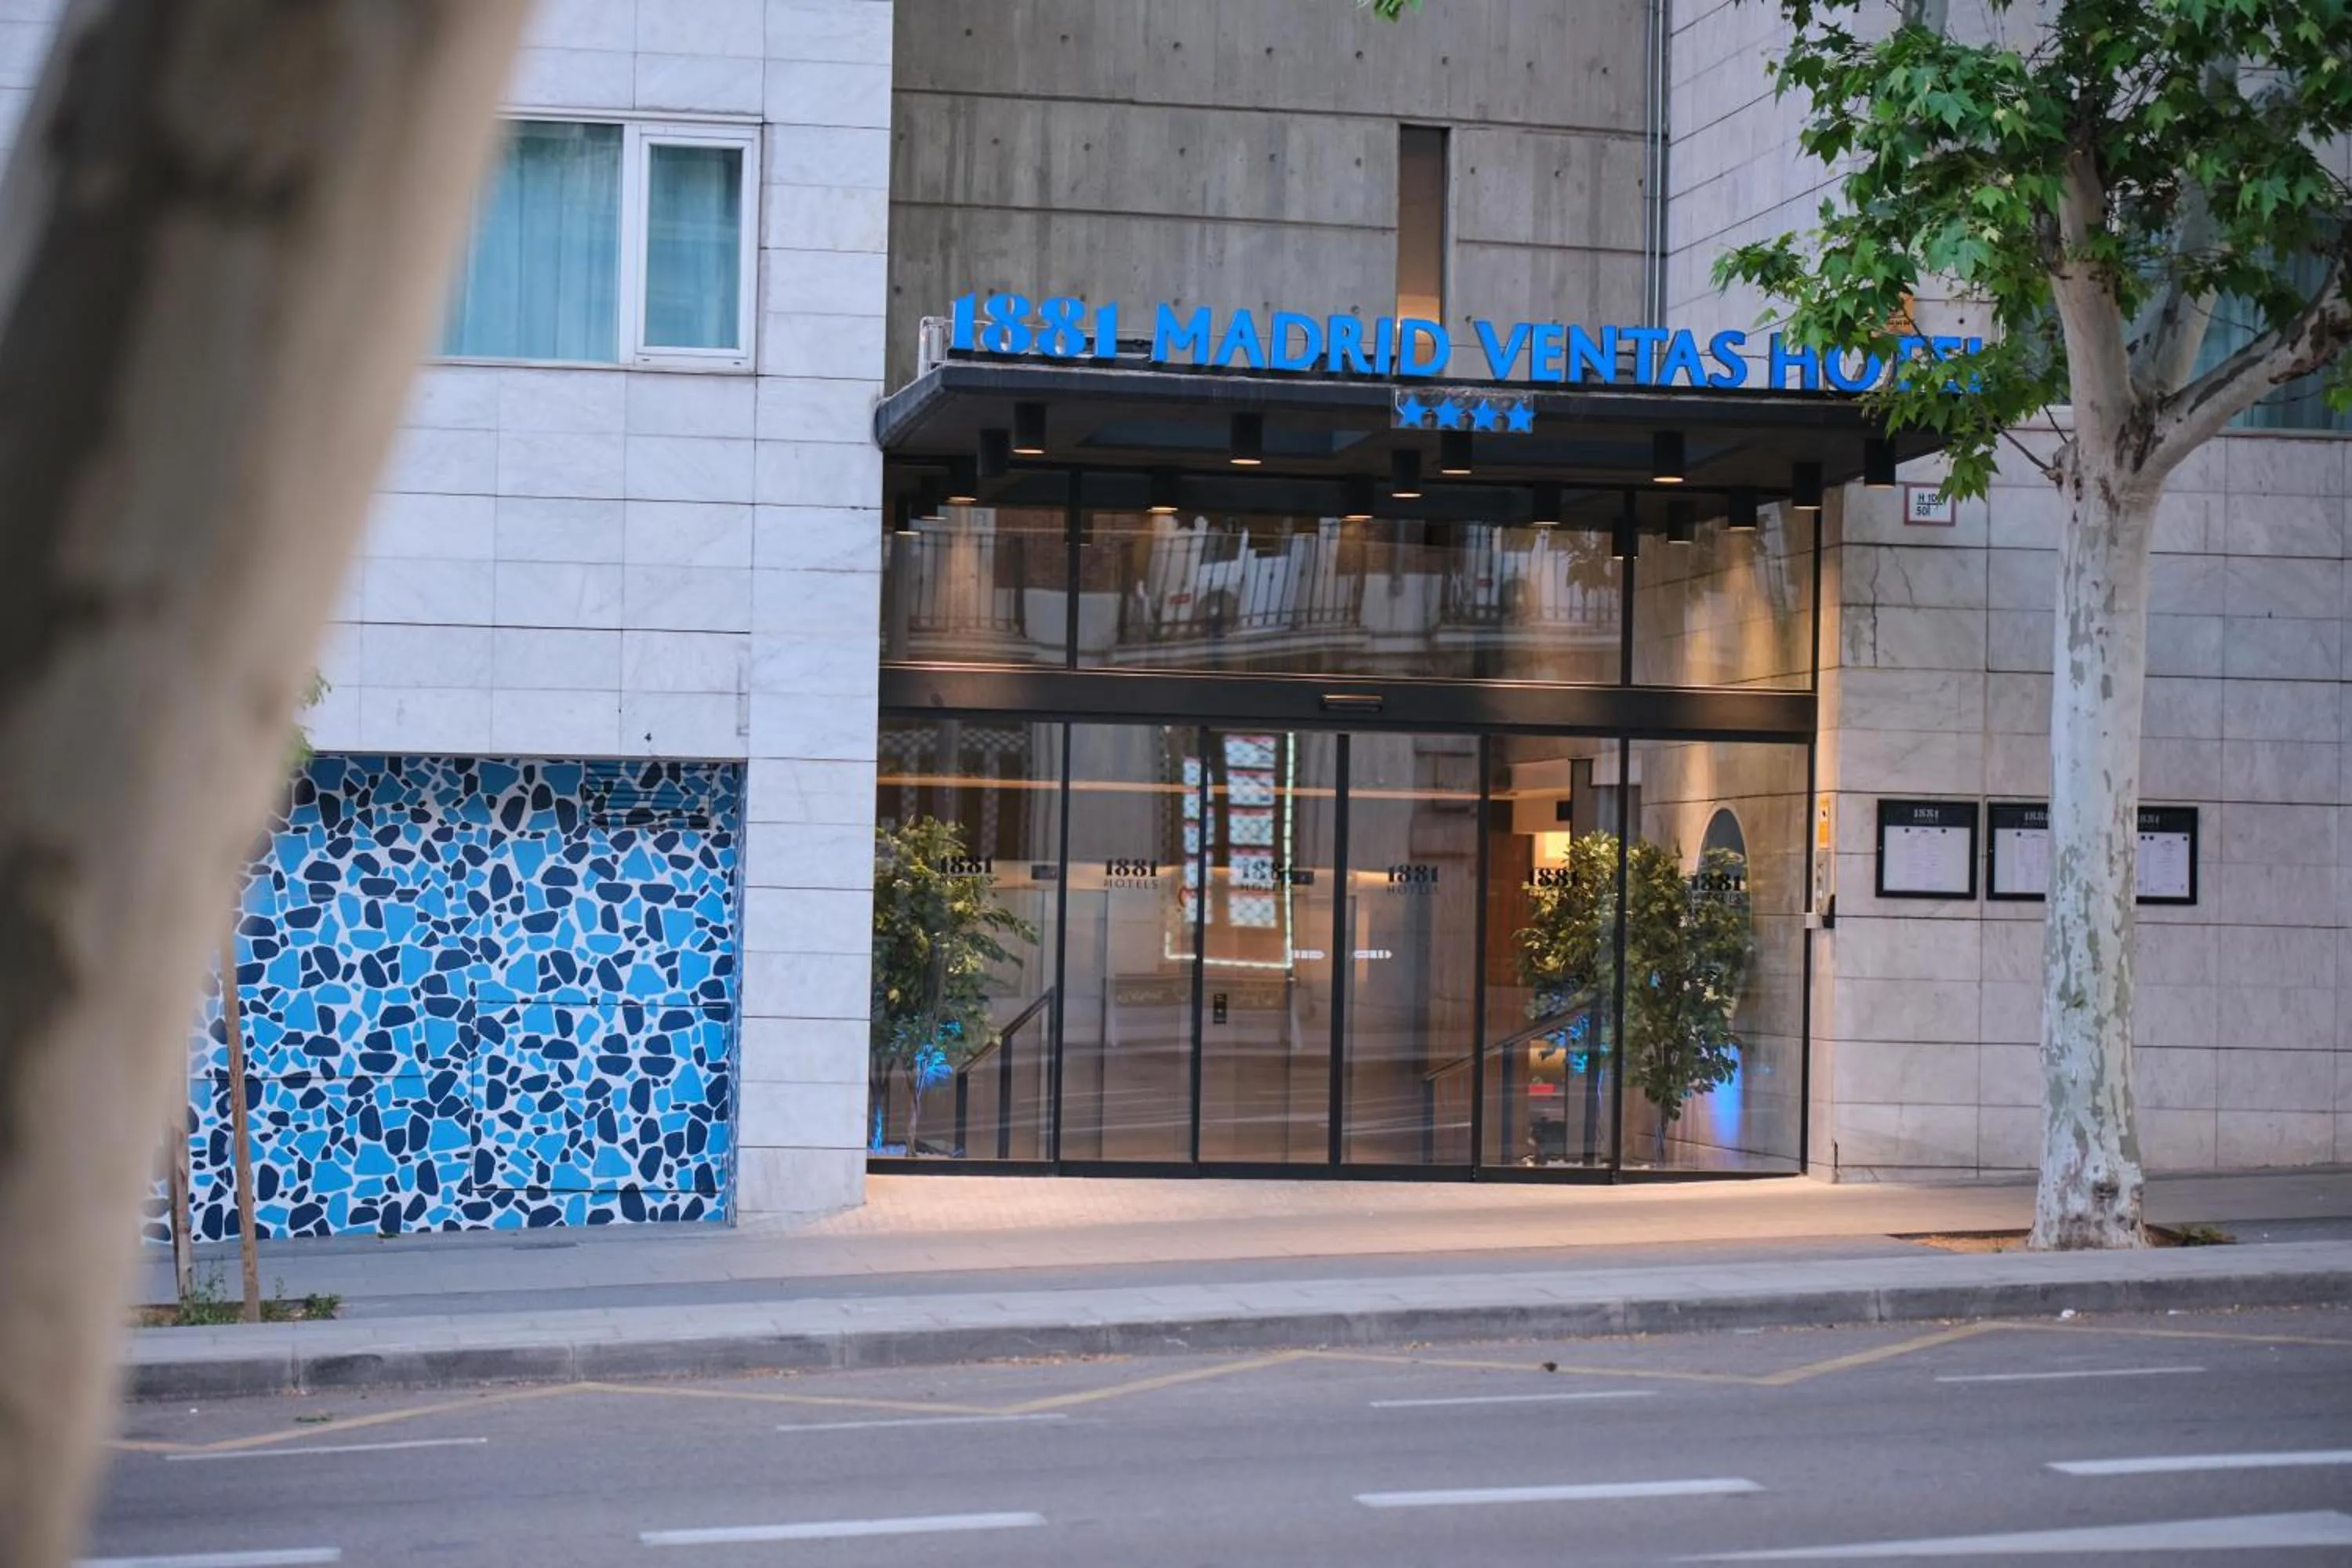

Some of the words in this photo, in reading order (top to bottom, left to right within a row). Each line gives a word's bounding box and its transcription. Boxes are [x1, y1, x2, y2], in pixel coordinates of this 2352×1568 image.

[950, 293, 1119, 360] 1881
[1152, 303, 1451, 377] MADRID
[1475, 321, 1748, 389] VENTAS
[1105, 858, 1156, 877] 1881
[1388, 865, 1438, 882] 1881
[1103, 878, 1158, 890] HOTELS
[1529, 868, 1577, 886] 1881
[1691, 873, 1740, 891] 1881
